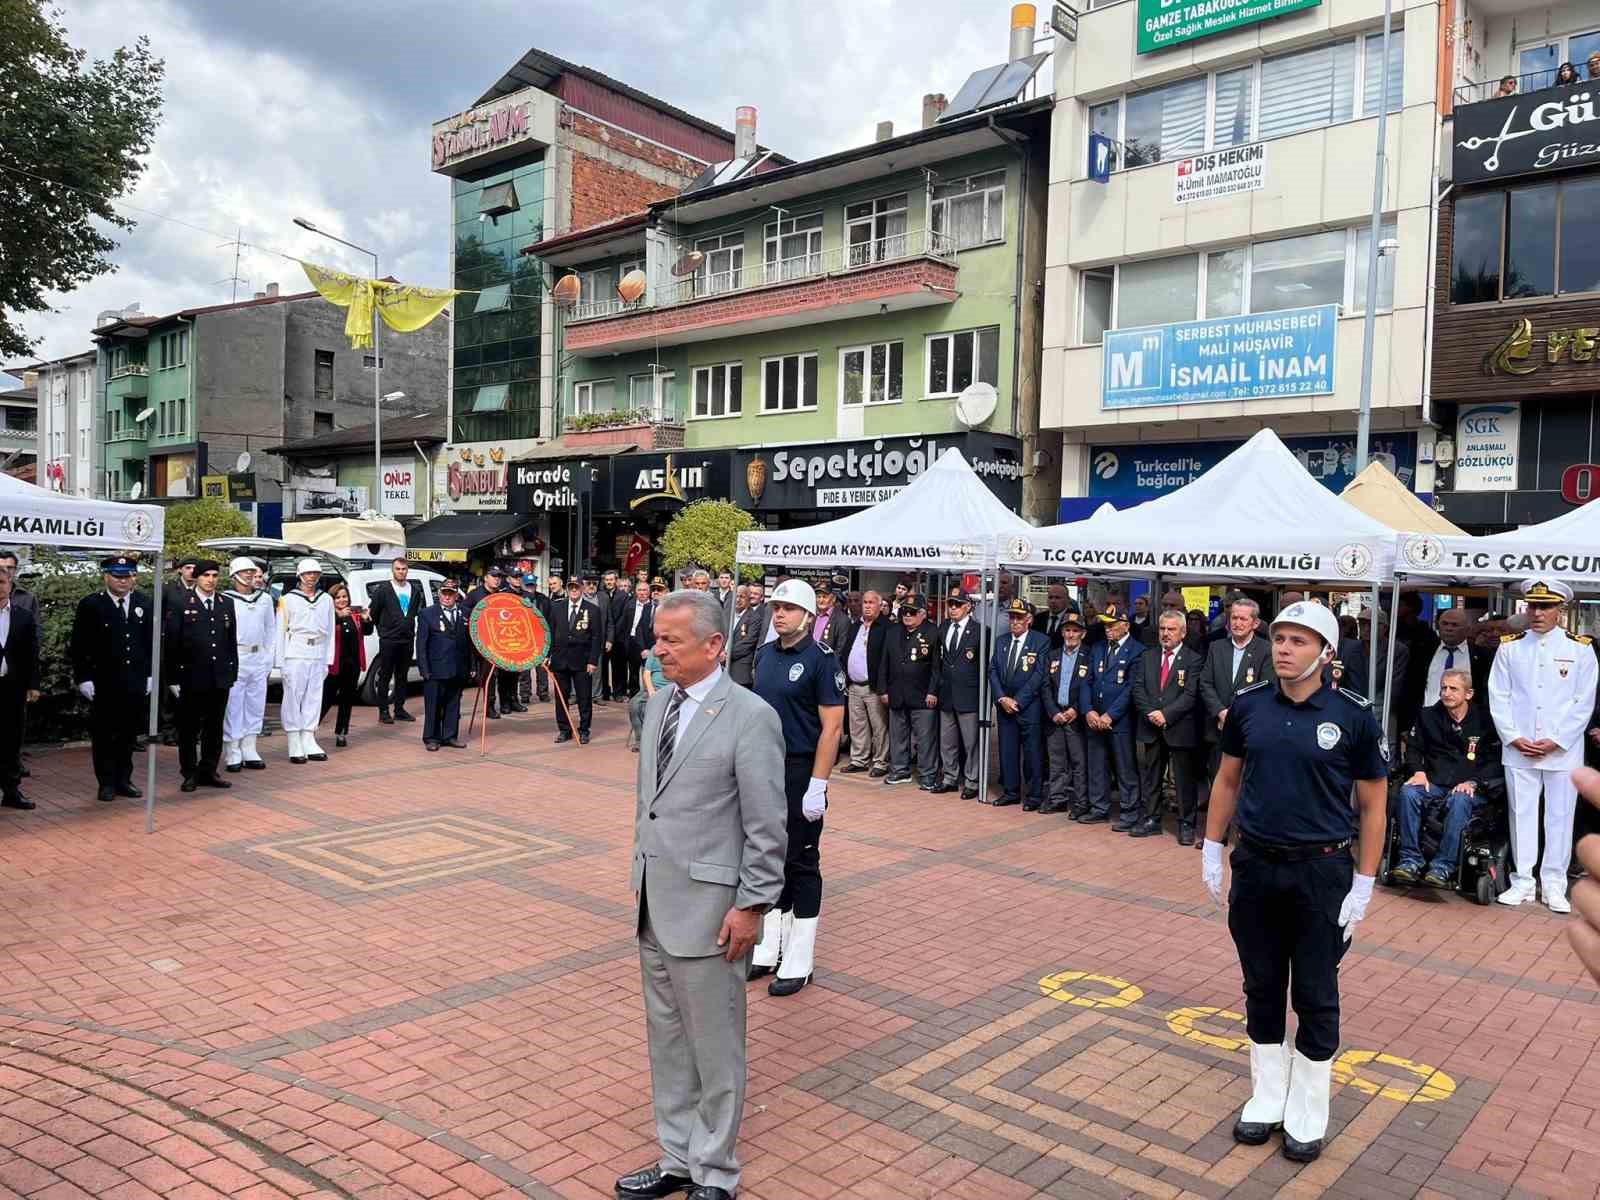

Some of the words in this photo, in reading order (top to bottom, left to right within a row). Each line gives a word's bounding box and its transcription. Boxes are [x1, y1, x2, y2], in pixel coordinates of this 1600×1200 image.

[1145, 10, 1182, 32] GAMZE
[1153, 28, 1173, 43] Özel
[1175, 21, 1202, 37] Sağlık
[1205, 13, 1237, 28] Meslek
[1239, 5, 1272, 19] Hizmet
[1530, 92, 1600, 131] Gü
[488, 103, 528, 145] AVM
[1533, 142, 1600, 168] Güz
[1206, 165, 1262, 186] MAMATOĞLU
[1175, 324, 1231, 342] SERBEST
[1234, 311, 1321, 335] MUHASEBECİ
[1199, 339, 1230, 357] MALİ
[1170, 357, 1251, 388] İSMAİL
[1259, 354, 1327, 381] İNAM
[1252, 384, 1276, 394] 0372
[1299, 381, 1313, 392] 22
[1314, 380, 1328, 391] 40
[1464, 417, 1501, 434] SGK
[1457, 453, 1514, 469] GÖZLÜKÇÜ
[384, 470, 412, 487] ONUR
[1137, 473, 1184, 488] bağlan
[385, 490, 410, 500] TEKEL
[842, 490, 848, 504] &
[850, 490, 877, 503] YEMEK
[782, 544, 837, 559] ÇAYCUMA
[1072, 549, 1156, 565] ÇAYCUMA
[1162, 552, 1321, 571] KAYMAKAMLIĞI
